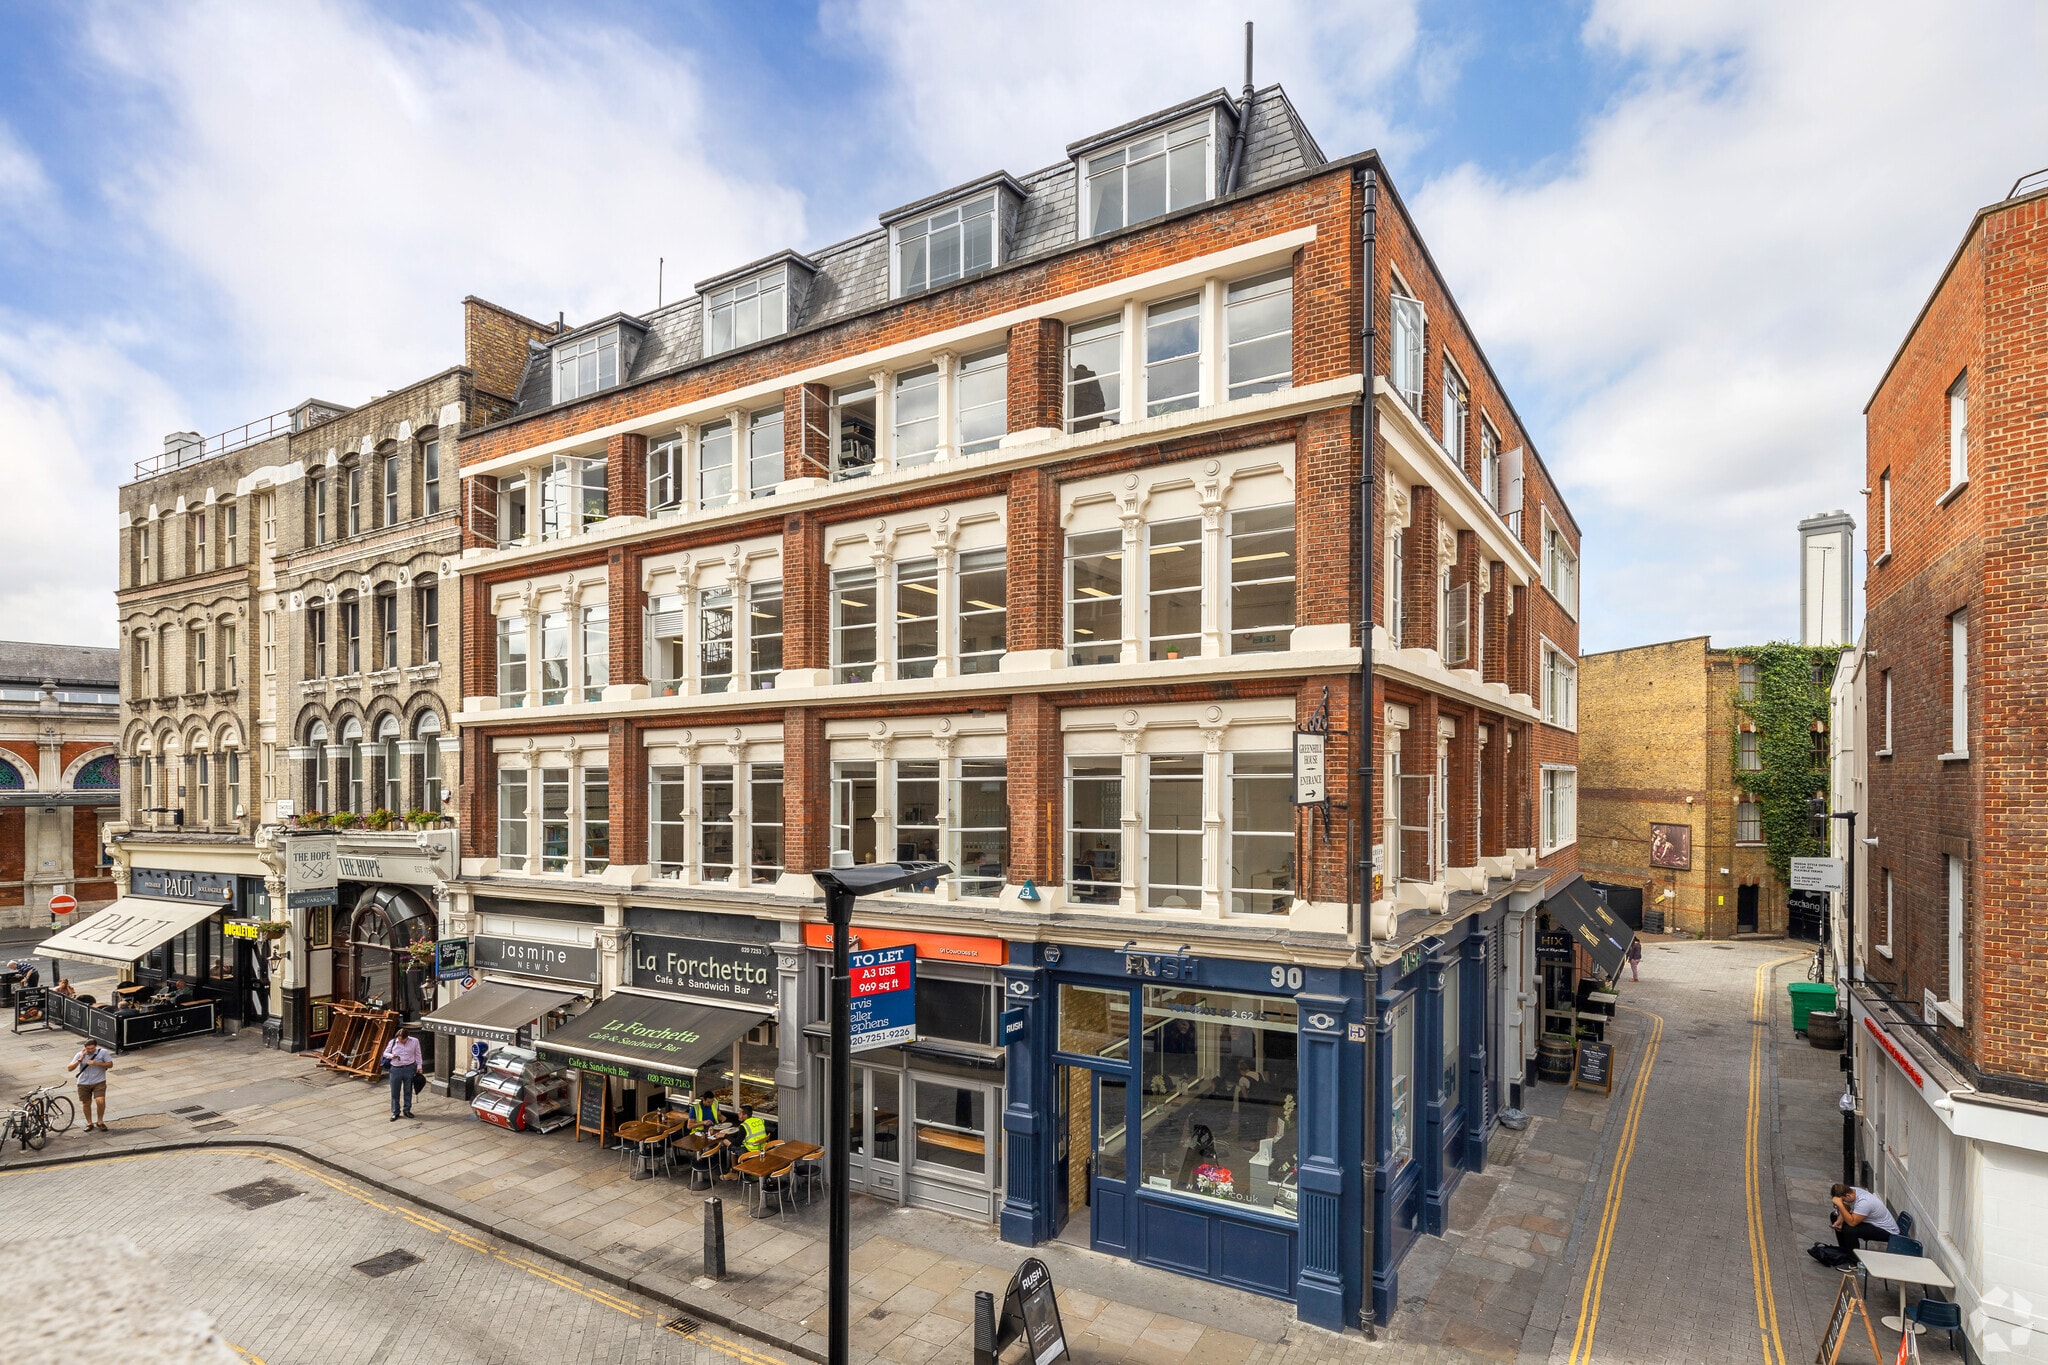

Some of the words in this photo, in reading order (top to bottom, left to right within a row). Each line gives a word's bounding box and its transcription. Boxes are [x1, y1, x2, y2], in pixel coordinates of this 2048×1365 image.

[1304, 755, 1318, 764] HOUSE
[1300, 775, 1322, 785] ENTRANCE
[293, 852, 308, 862] THE
[310, 851, 331, 860] HOPE
[339, 858, 357, 876] THE
[357, 859, 383, 878] HOPE
[164, 878, 195, 897] PAUL
[70, 913, 175, 947] PAUL
[1541, 936, 1563, 945] HIX
[502, 941, 567, 963] jasmine
[853, 954, 875, 967] TO
[878, 949, 904, 964] LET
[518, 961, 549, 972] NEWS
[637, 949, 656, 971] La
[667, 952, 768, 985] Forchetta
[862, 968, 876, 979] A3
[878, 965, 896, 977] USE
[1125, 953, 1200, 981] RUSH
[1270, 965, 1303, 990] 90
[655, 975, 674, 985] Cafe
[677, 978, 684, 986] &
[688, 979, 730, 993] Sandwich
[734, 984, 750, 995] Bar
[859, 982, 876, 993] 969
[878, 982, 890, 991] sq
[890, 978, 899, 988] ft
[153, 1016, 188, 1030] PAUL
[850, 1011, 872, 1022] eller
[438, 1025, 457, 1033] HOUR
[477, 1030, 511, 1041] LICENCE
[601, 1019, 624, 1031] La
[622, 1021, 700, 1044] Forchetta
[1006, 1020, 1023, 1034] RUSH
[588, 1032, 607, 1040] Cafe
[618, 1037, 663, 1050] Sandwich
[662, 1043, 682, 1053] Bar
[850, 1029, 910, 1046] 20-7251-9226
[568, 1057, 582, 1068] Cafe
[582, 1061, 588, 1069] &
[588, 1062, 617, 1075] Sandwich
[618, 1066, 630, 1078] Bar
[647, 1073, 659, 1082] 020
[660, 1075, 675, 1086] 7253
[1021, 1267, 1043, 1290] RUSH
